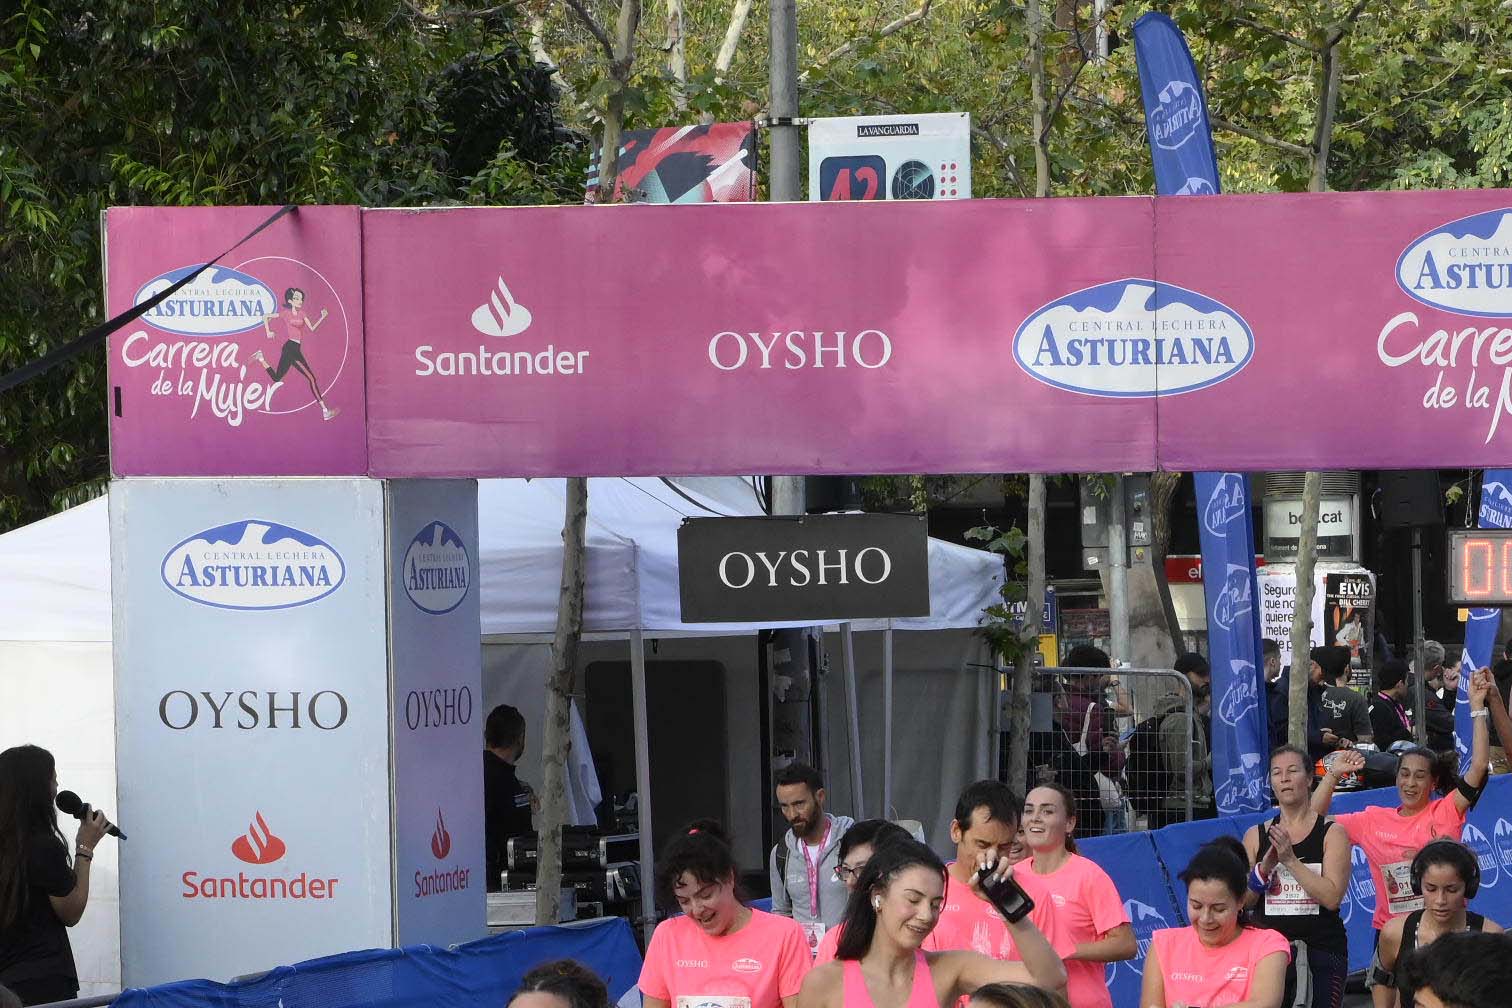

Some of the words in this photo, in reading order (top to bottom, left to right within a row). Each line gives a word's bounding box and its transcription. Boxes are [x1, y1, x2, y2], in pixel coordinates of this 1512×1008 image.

[172, 288, 213, 297] ENTRAL
[1069, 321, 1142, 332] CENTRAL
[1152, 319, 1227, 331] LECHERA
[122, 331, 239, 369] Carrera
[415, 344, 590, 377] Santander
[708, 329, 892, 370] OYSHO
[1032, 324, 1236, 366] ASTURIANA
[151, 370, 172, 396] de
[178, 370, 194, 396] la
[191, 364, 284, 427] Mujer
[1423, 371, 1457, 409] de
[1465, 369, 1490, 409] la
[176, 553, 332, 587] ASTURIANA
[203, 552, 263, 560] CENTRAL
[267, 552, 326, 560] LECHERA
[408, 551, 467, 591] ASTURIANA
[718, 546, 892, 589] OYSHO
[1339, 583, 1370, 595] ELVIS
[1265, 611, 1295, 623] quiere
[159, 690, 348, 730] OYSHO
[405, 686, 472, 730] OYSHO
[182, 871, 339, 899] Santander
[415, 864, 470, 899] Santander
